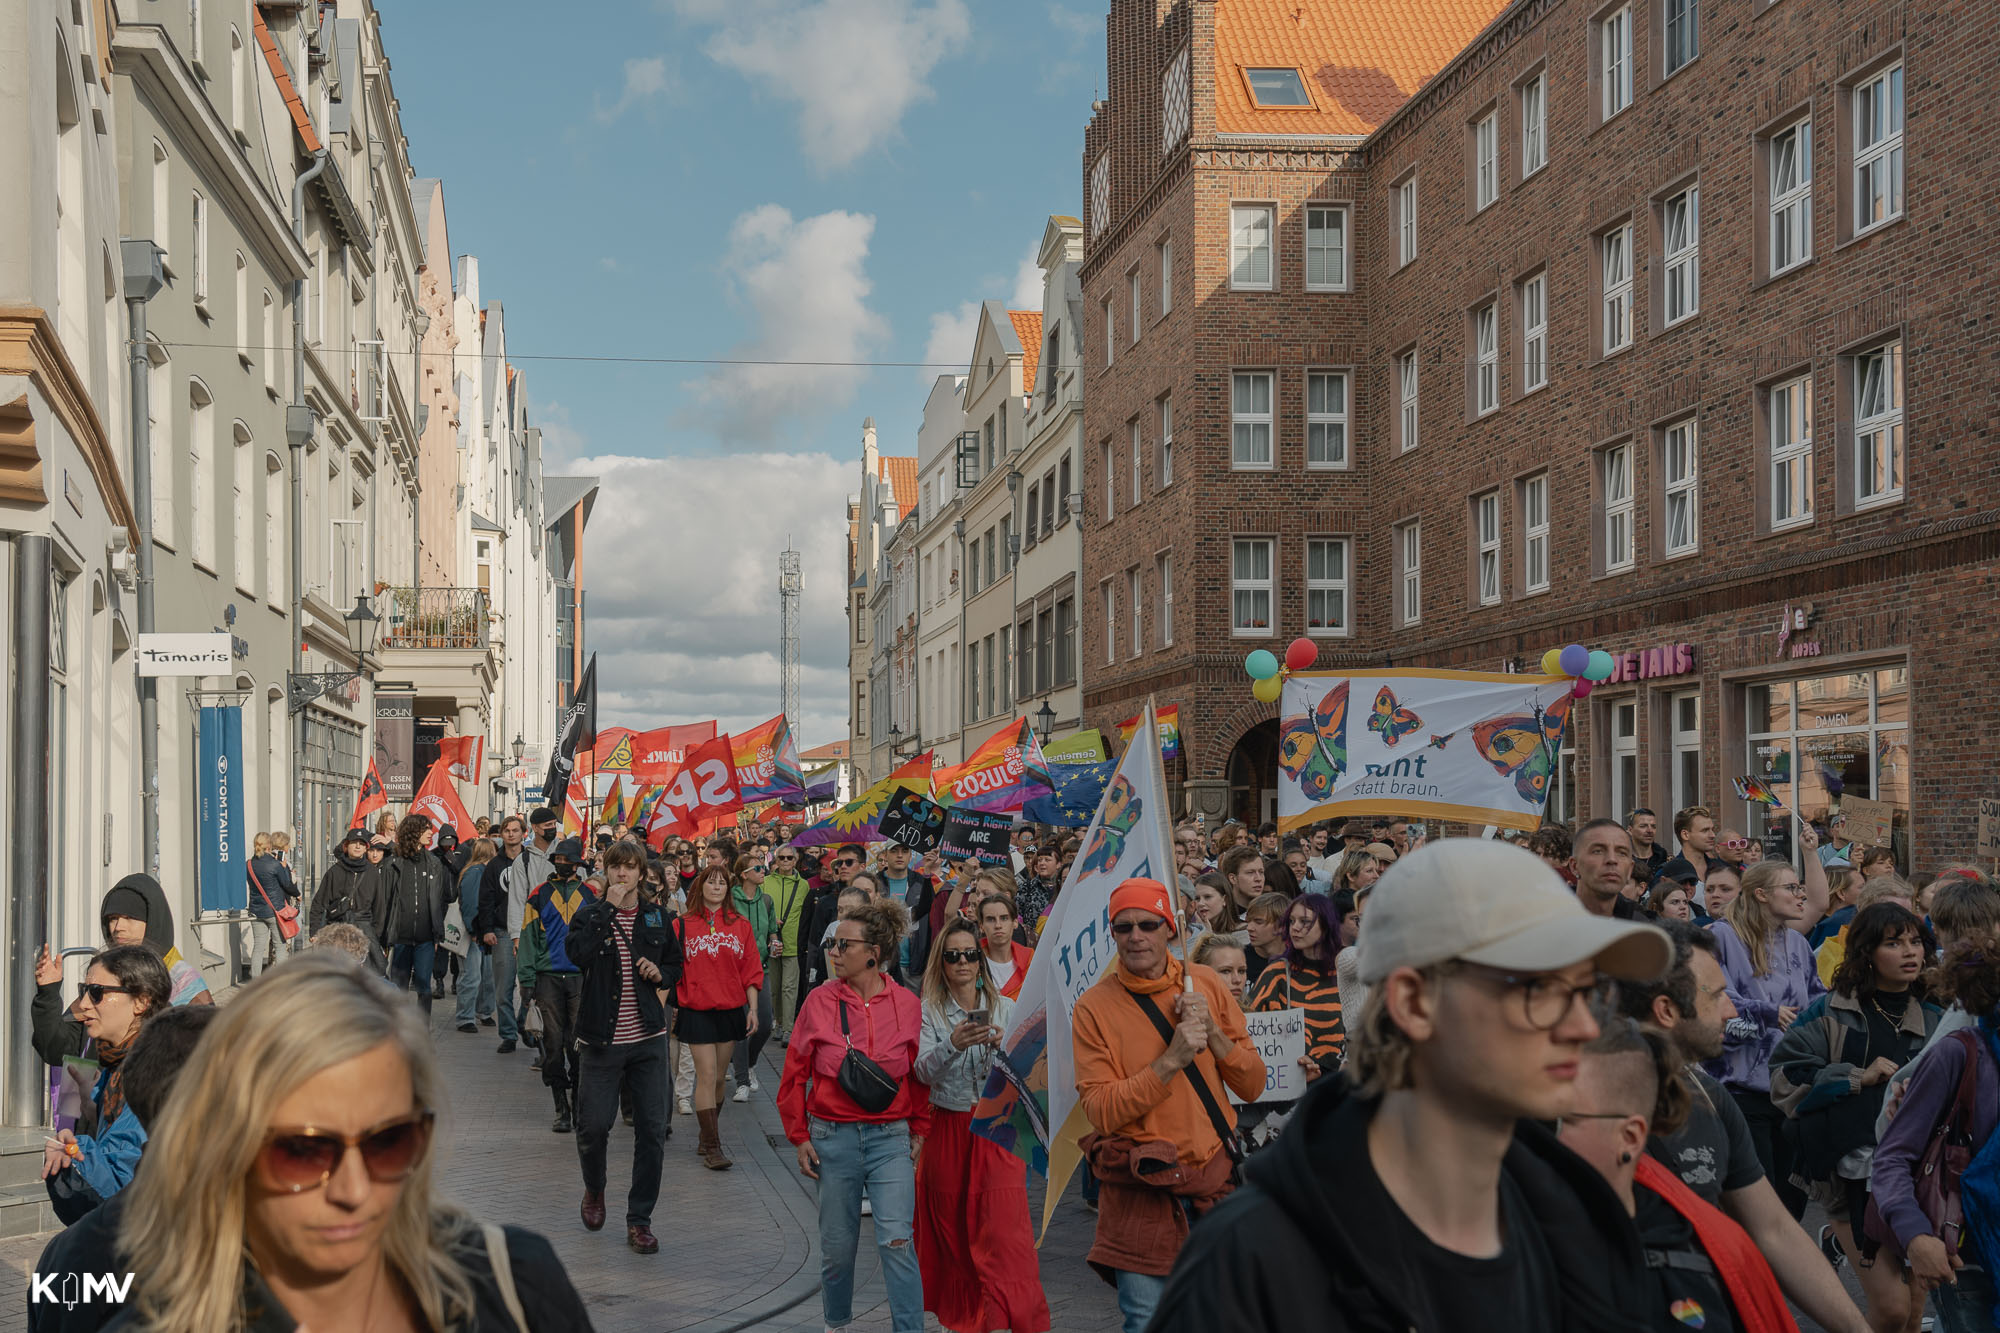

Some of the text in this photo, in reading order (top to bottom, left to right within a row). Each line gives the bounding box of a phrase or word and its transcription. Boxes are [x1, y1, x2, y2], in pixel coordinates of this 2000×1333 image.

[376, 708, 411, 717] KROHN
[1816, 713, 1849, 728] DAMEN
[515, 769, 527, 779] kik
[1353, 779, 1443, 797] statt braun.
[902, 794, 944, 828] CSD
[1981, 799, 2000, 817] SOU
[951, 810, 980, 826] TRANS
[219, 809, 229, 862] TAILOR
[893, 823, 921, 847] AFD
[969, 830, 990, 844] ARE
[941, 840, 972, 859] HUMAN
[1247, 1015, 1303, 1037] stört's dich
[1264, 1039, 1283, 1057] ich
